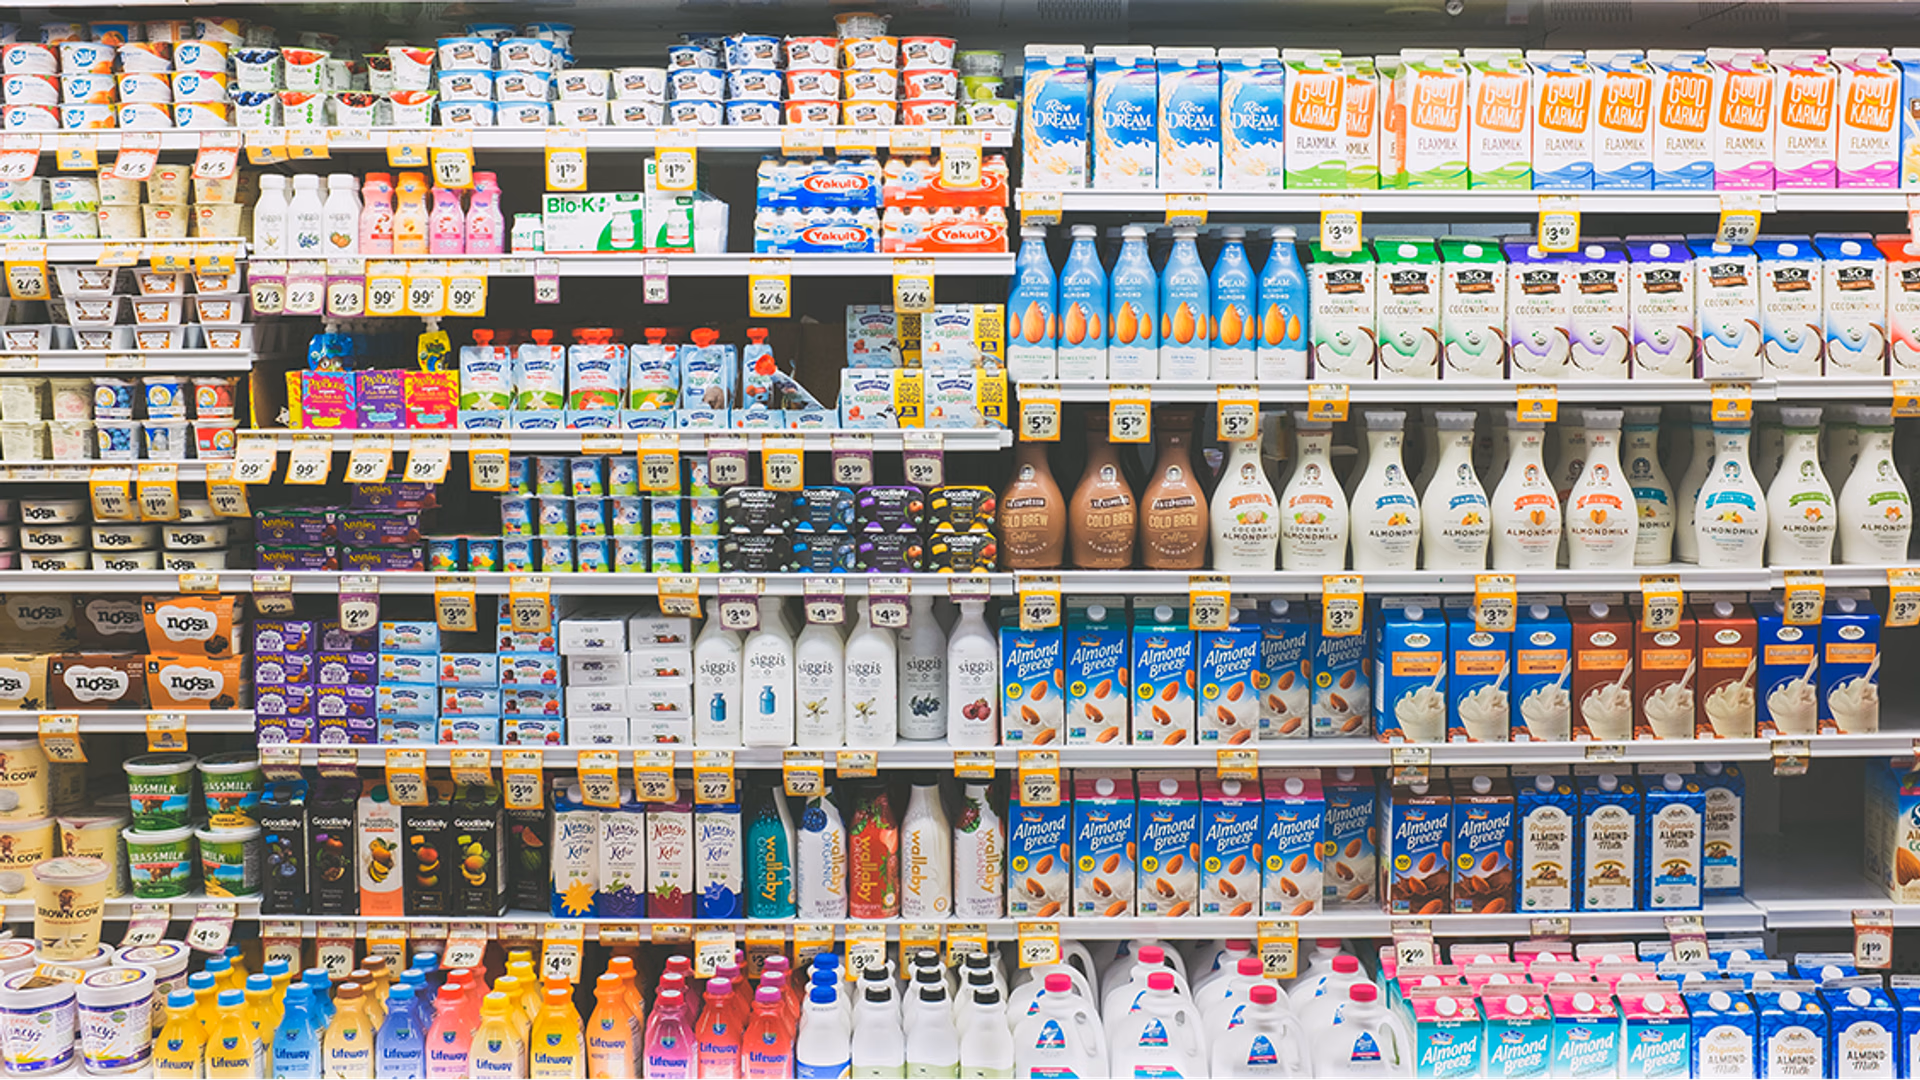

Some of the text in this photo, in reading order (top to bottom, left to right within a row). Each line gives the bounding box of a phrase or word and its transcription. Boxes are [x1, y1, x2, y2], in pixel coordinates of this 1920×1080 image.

[1299, 74, 1338, 105] GOOD
[1484, 75, 1525, 106] GOOD
[1669, 75, 1708, 106] GOOD
[1791, 75, 1829, 105] GOOD
[1045, 100, 1071, 113] Rice
[1116, 101, 1142, 113] Rice
[1179, 101, 1205, 114] Rice
[1242, 101, 1268, 114] Rice
[1034, 111, 1081, 128] DREAM
[1105, 112, 1152, 130] DREAM
[1168, 112, 1215, 130] DREAM
[1232, 112, 1278, 128] DREAM
[1295, 104, 1339, 126] KARMA
[1481, 104, 1523, 128] KARMA
[1665, 105, 1706, 128] KARMA
[1787, 104, 1828, 127] KARMA
[1297, 137, 1336, 149] FLAXMILK
[1482, 138, 1522, 150] FLAXMILK
[1666, 138, 1706, 150] FLAXMILK
[1788, 137, 1827, 149] FLAXMILK
[815, 179, 860, 189] Yakult
[813, 231, 859, 241] Yakult
[942, 229, 988, 240] Yakult
[17, 279, 41, 290] 2/3
[257, 292, 280, 303] 2/3
[292, 291, 315, 302] 2/3
[335, 293, 359, 305] 2/3
[759, 293, 783, 304] 2/6
[903, 292, 926, 303] 2/6
[739, 490, 776, 500] GoodBelly
[803, 490, 840, 499] GoodBelly
[871, 489, 908, 499] GoodBelly
[25, 507, 56, 519] noosa
[1002, 514, 1048, 527] COLD BREW
[1149, 514, 1198, 527] COLD BREW
[1571, 528, 1629, 536] ALMONDMILK
[1702, 527, 1758, 535] ALMONDMILK
[29, 533, 63, 545] noosa
[100, 533, 132, 545] noosa
[172, 533, 205, 545] noosa
[18, 606, 62, 620] noosa
[167, 616, 208, 632] noosa
[1006, 641, 1059, 668] Almond
[1070, 639, 1123, 666] Almond
[1138, 641, 1191, 668] Almond
[1203, 641, 1257, 668] Almond
[1017, 656, 1054, 678] Breeze
[1082, 655, 1118, 676] Breeze
[1149, 656, 1186, 678] Breeze
[1214, 656, 1251, 678] Breeze
[76, 676, 119, 691] noosa
[261, 818, 301, 829] GoodBelly
[312, 817, 351, 827] GoodBelly
[407, 819, 448, 829] GoodBelly
[454, 819, 495, 829] GoodBelly
[1012, 816, 1066, 841] Almond
[1143, 815, 1196, 841] Almond
[1267, 814, 1320, 840] Almond
[1396, 814, 1448, 839] Almond
[1529, 823, 1566, 833] Organic
[1658, 821, 1695, 831] Organic
[1024, 832, 1060, 851] Breeze
[1154, 831, 1191, 851] Breeze
[1279, 830, 1315, 851] Breeze
[1407, 829, 1443, 850] Breeze
[1530, 832, 1566, 842] ALMOND
[1660, 831, 1696, 840] ALMOND
[1535, 841, 1561, 851] Milk
[1664, 839, 1690, 849] Milk
[822, 831, 833, 887] ORGANIC
[827, 829, 845, 896] wallaby
[976, 830, 986, 886] ORGANIC
[981, 829, 999, 895] wallaby
[756, 837, 766, 894] ORGANIC
[762, 835, 783, 901] wallaby
[857, 835, 878, 902] wallaby
[76, 907, 99, 918] COW
[590, 1038, 625, 1050] Lifeway
[1421, 1035, 1477, 1066] Almond
[1630, 1034, 1686, 1063] Almond
[1776, 1045, 1815, 1055] Organic
[275, 1049, 310, 1061] Lifeway
[384, 1049, 421, 1061] Lifeway
[535, 1053, 573, 1066] Lifeway
[1777, 1056, 1816, 1065] ALMOND
[212, 1057, 251, 1070] Lifeway
[477, 1059, 512, 1072] Lifeway
[650, 1057, 687, 1070] Lifeway
[1433, 1053, 1471, 1076] Breeze
[1642, 1052, 1681, 1074] Breeze
[1781, 1065, 1810, 1075] Milk
